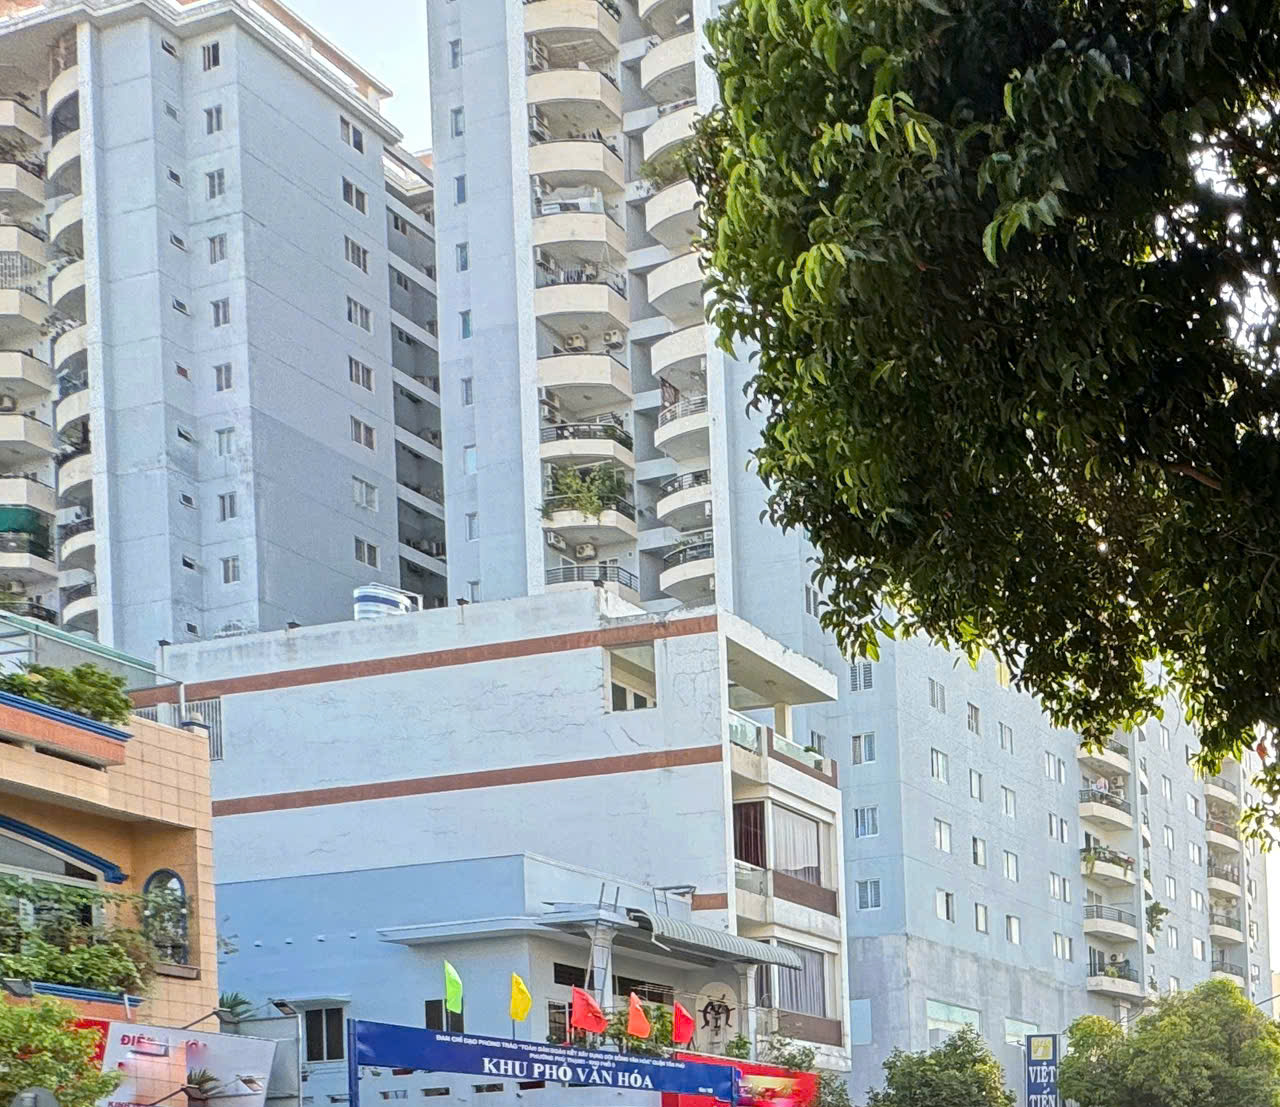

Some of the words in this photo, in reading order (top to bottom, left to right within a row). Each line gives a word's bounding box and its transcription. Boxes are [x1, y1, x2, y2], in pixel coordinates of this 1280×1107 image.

[482, 1057, 528, 1077] KHU
[577, 1064, 617, 1085] VĂN
[618, 1069, 654, 1089] HÓA
[1028, 1061, 1057, 1087] VIỆT
